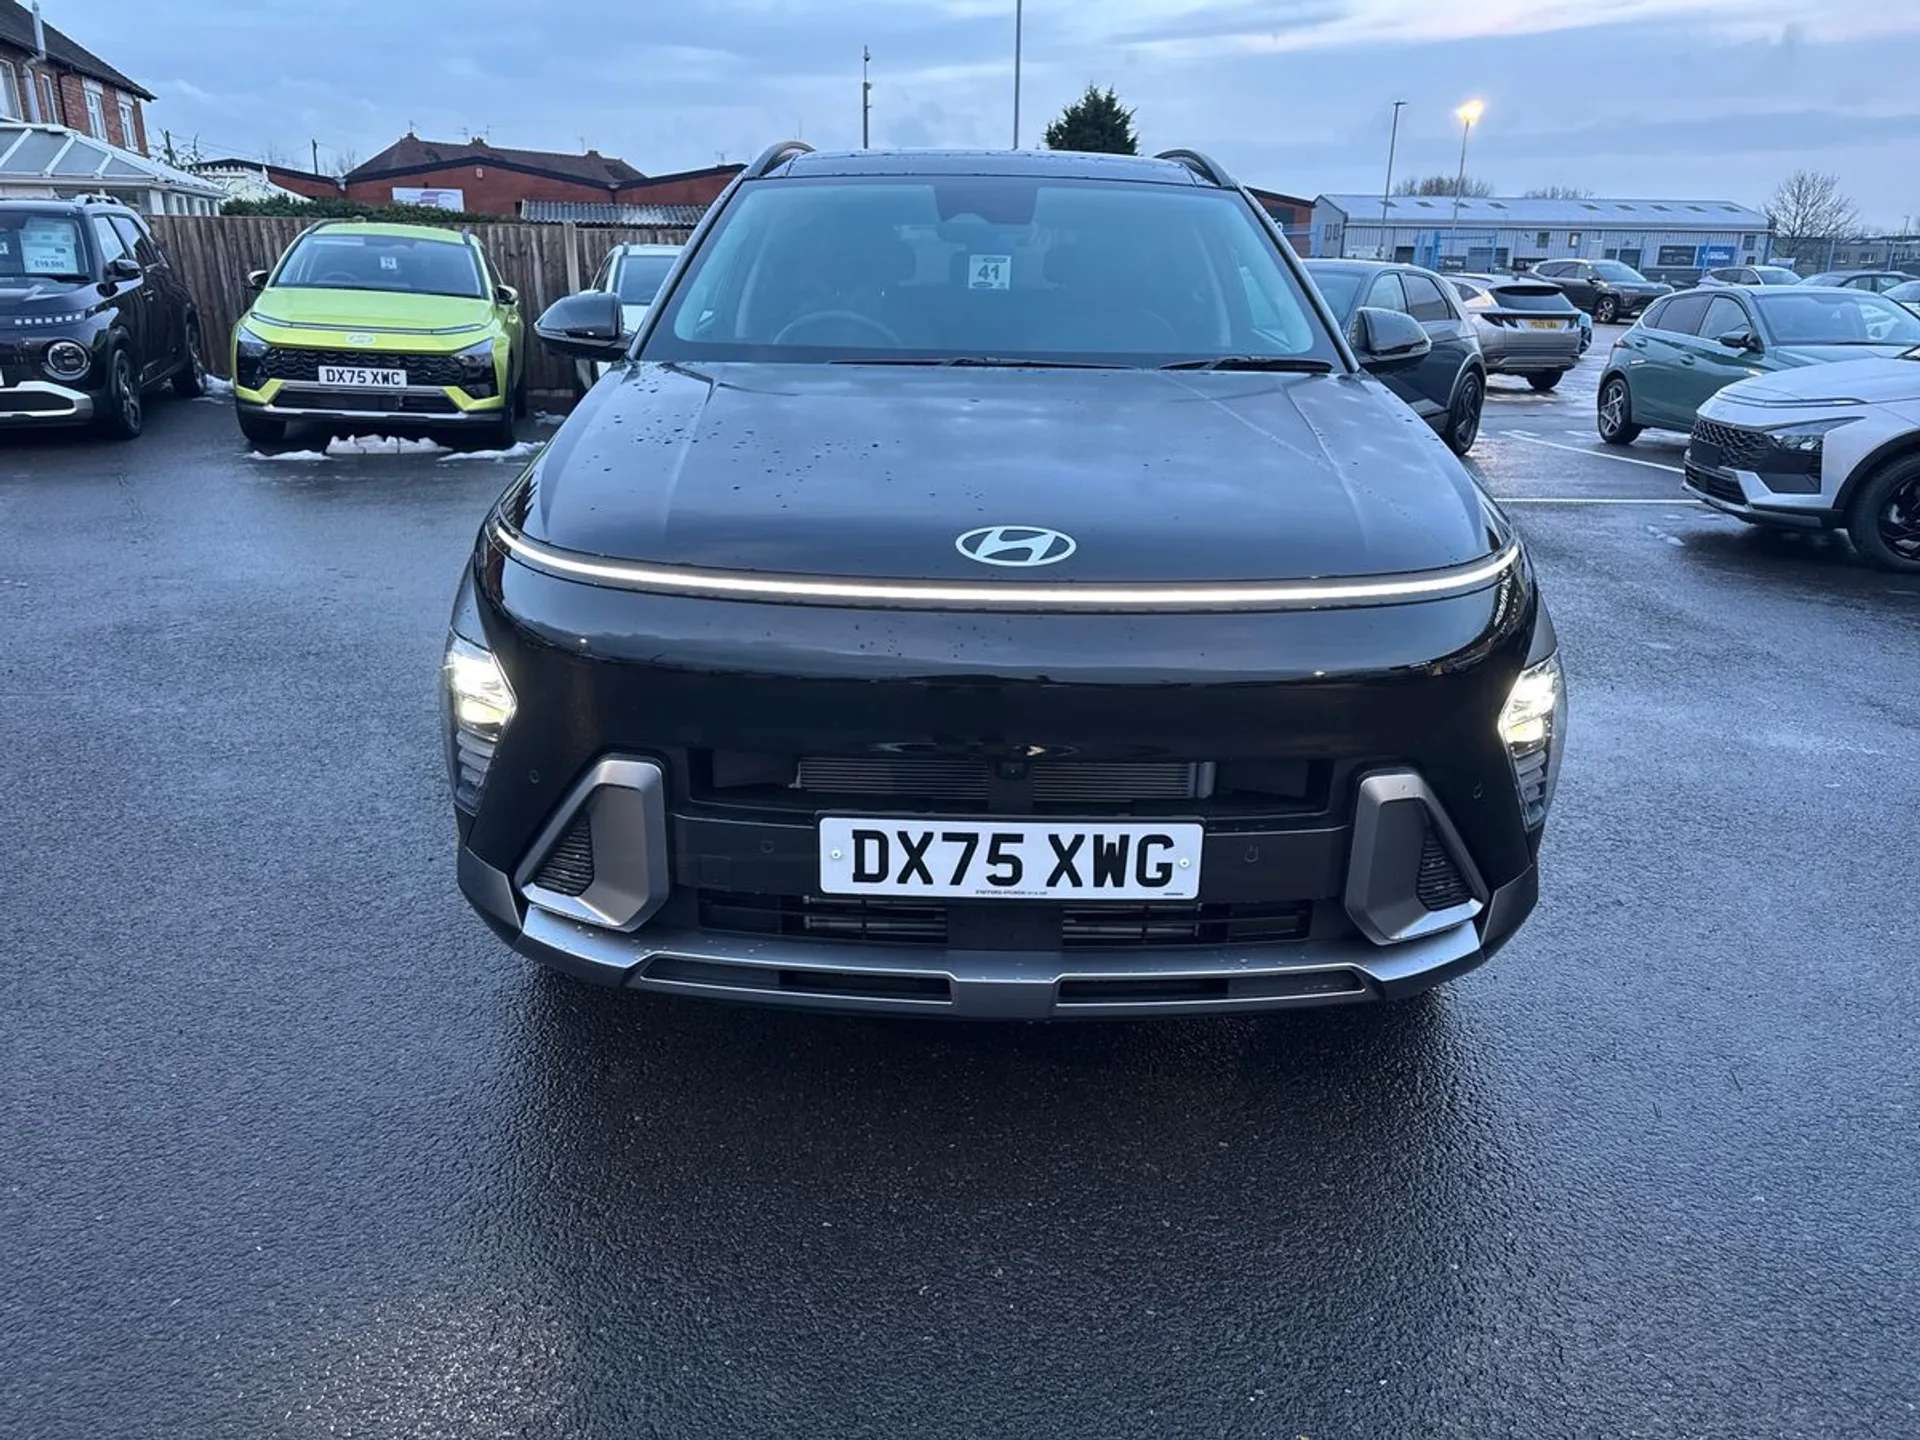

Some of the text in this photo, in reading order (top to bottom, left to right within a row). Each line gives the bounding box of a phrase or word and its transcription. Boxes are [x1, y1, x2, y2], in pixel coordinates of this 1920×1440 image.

[978, 264, 1000, 280] 41
[326, 369, 400, 385] DX75 XWC
[852, 829, 1175, 888] DX75 XWG
